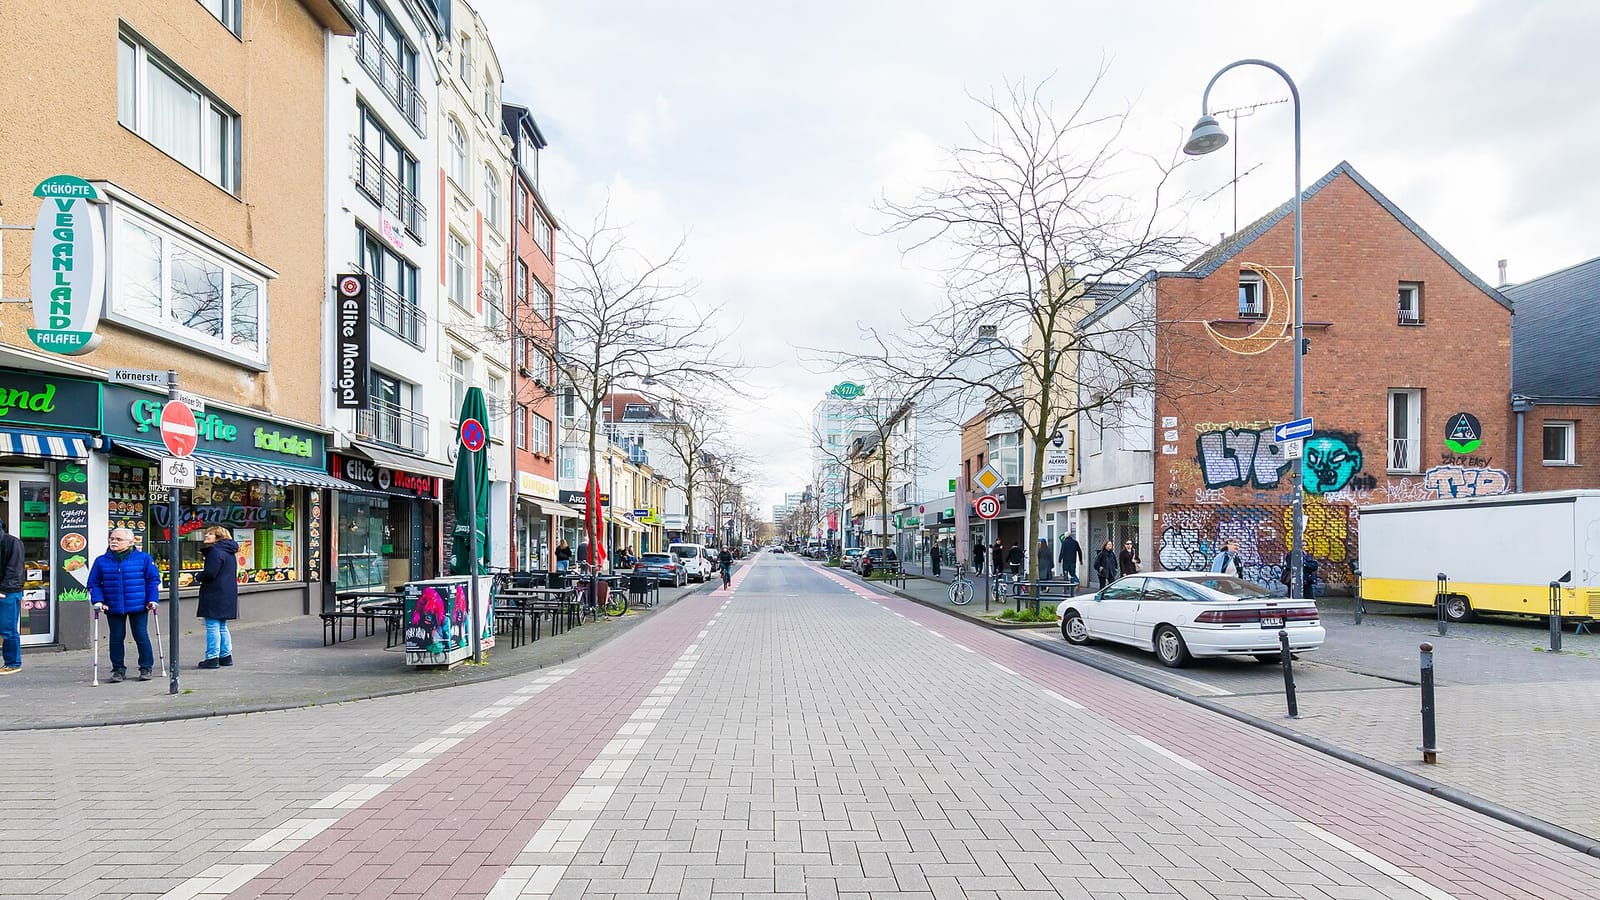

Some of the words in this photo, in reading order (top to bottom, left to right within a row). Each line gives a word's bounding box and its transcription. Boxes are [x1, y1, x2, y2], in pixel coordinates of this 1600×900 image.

[50, 198, 74, 330] VEGANLAND
[342, 299, 359, 338] Elite
[37, 333, 82, 345] FALAFEL
[115, 370, 161, 382] Körnerstr.
[339, 342, 359, 405] Mangal
[253, 426, 313, 458] falafel
[346, 459, 374, 482] Elite
[394, 469, 431, 495] Mangal
[149, 493, 169, 502] OPE
[1195, 487, 1230, 503] SUPER
[981, 502, 995, 513] 30
